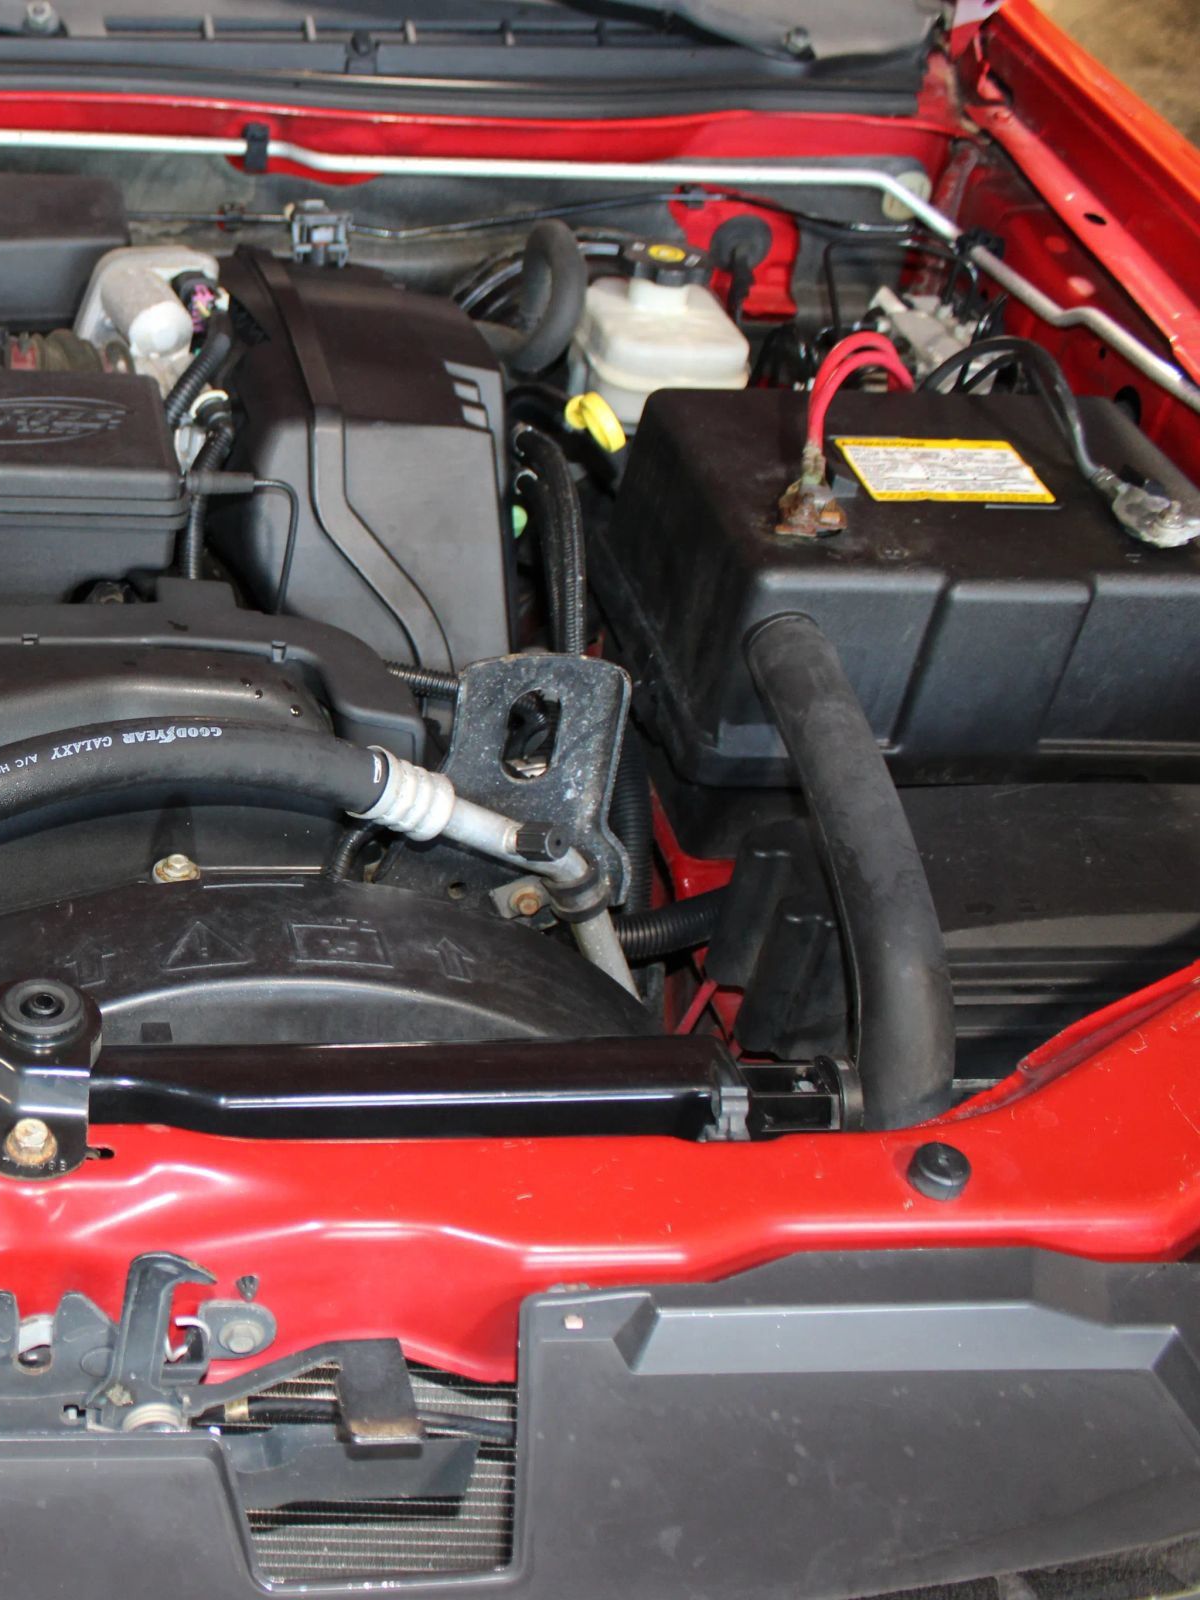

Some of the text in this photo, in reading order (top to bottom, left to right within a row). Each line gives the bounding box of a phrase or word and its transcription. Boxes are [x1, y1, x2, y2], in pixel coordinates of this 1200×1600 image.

[122, 726, 223, 744] GOODYEAR
[50, 735, 113, 761] GALAXY
[15, 753, 38, 768] A/C
